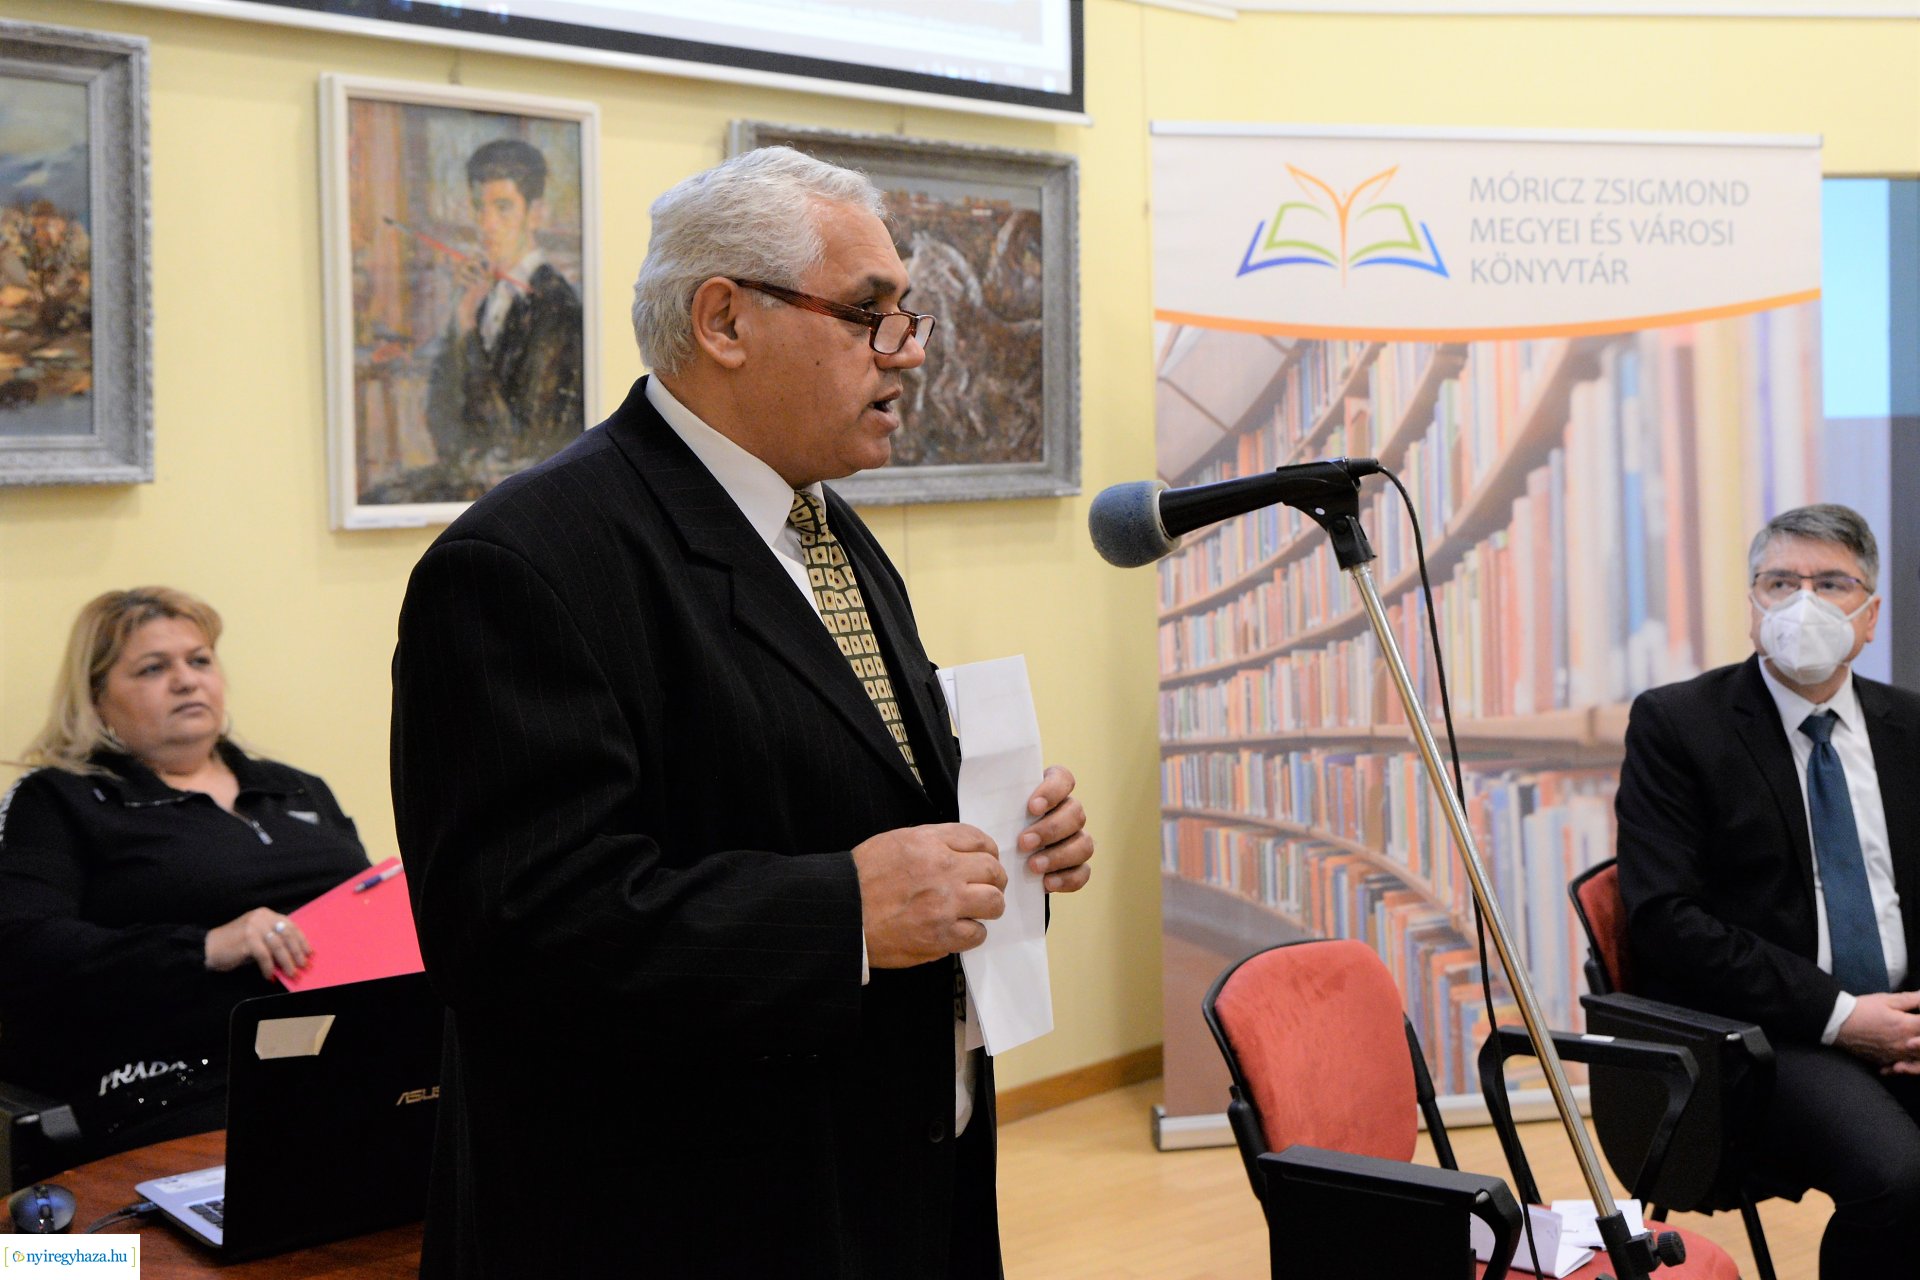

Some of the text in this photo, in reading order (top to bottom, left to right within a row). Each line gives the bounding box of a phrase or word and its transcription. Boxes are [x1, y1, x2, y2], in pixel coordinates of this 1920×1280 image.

[1469, 170, 1750, 207] MÓRICZ ZSIGMOND
[1469, 212, 1735, 246] MEGYEI ÉS VÁROSI
[1470, 252, 1630, 285] KÖNYVTÁR
